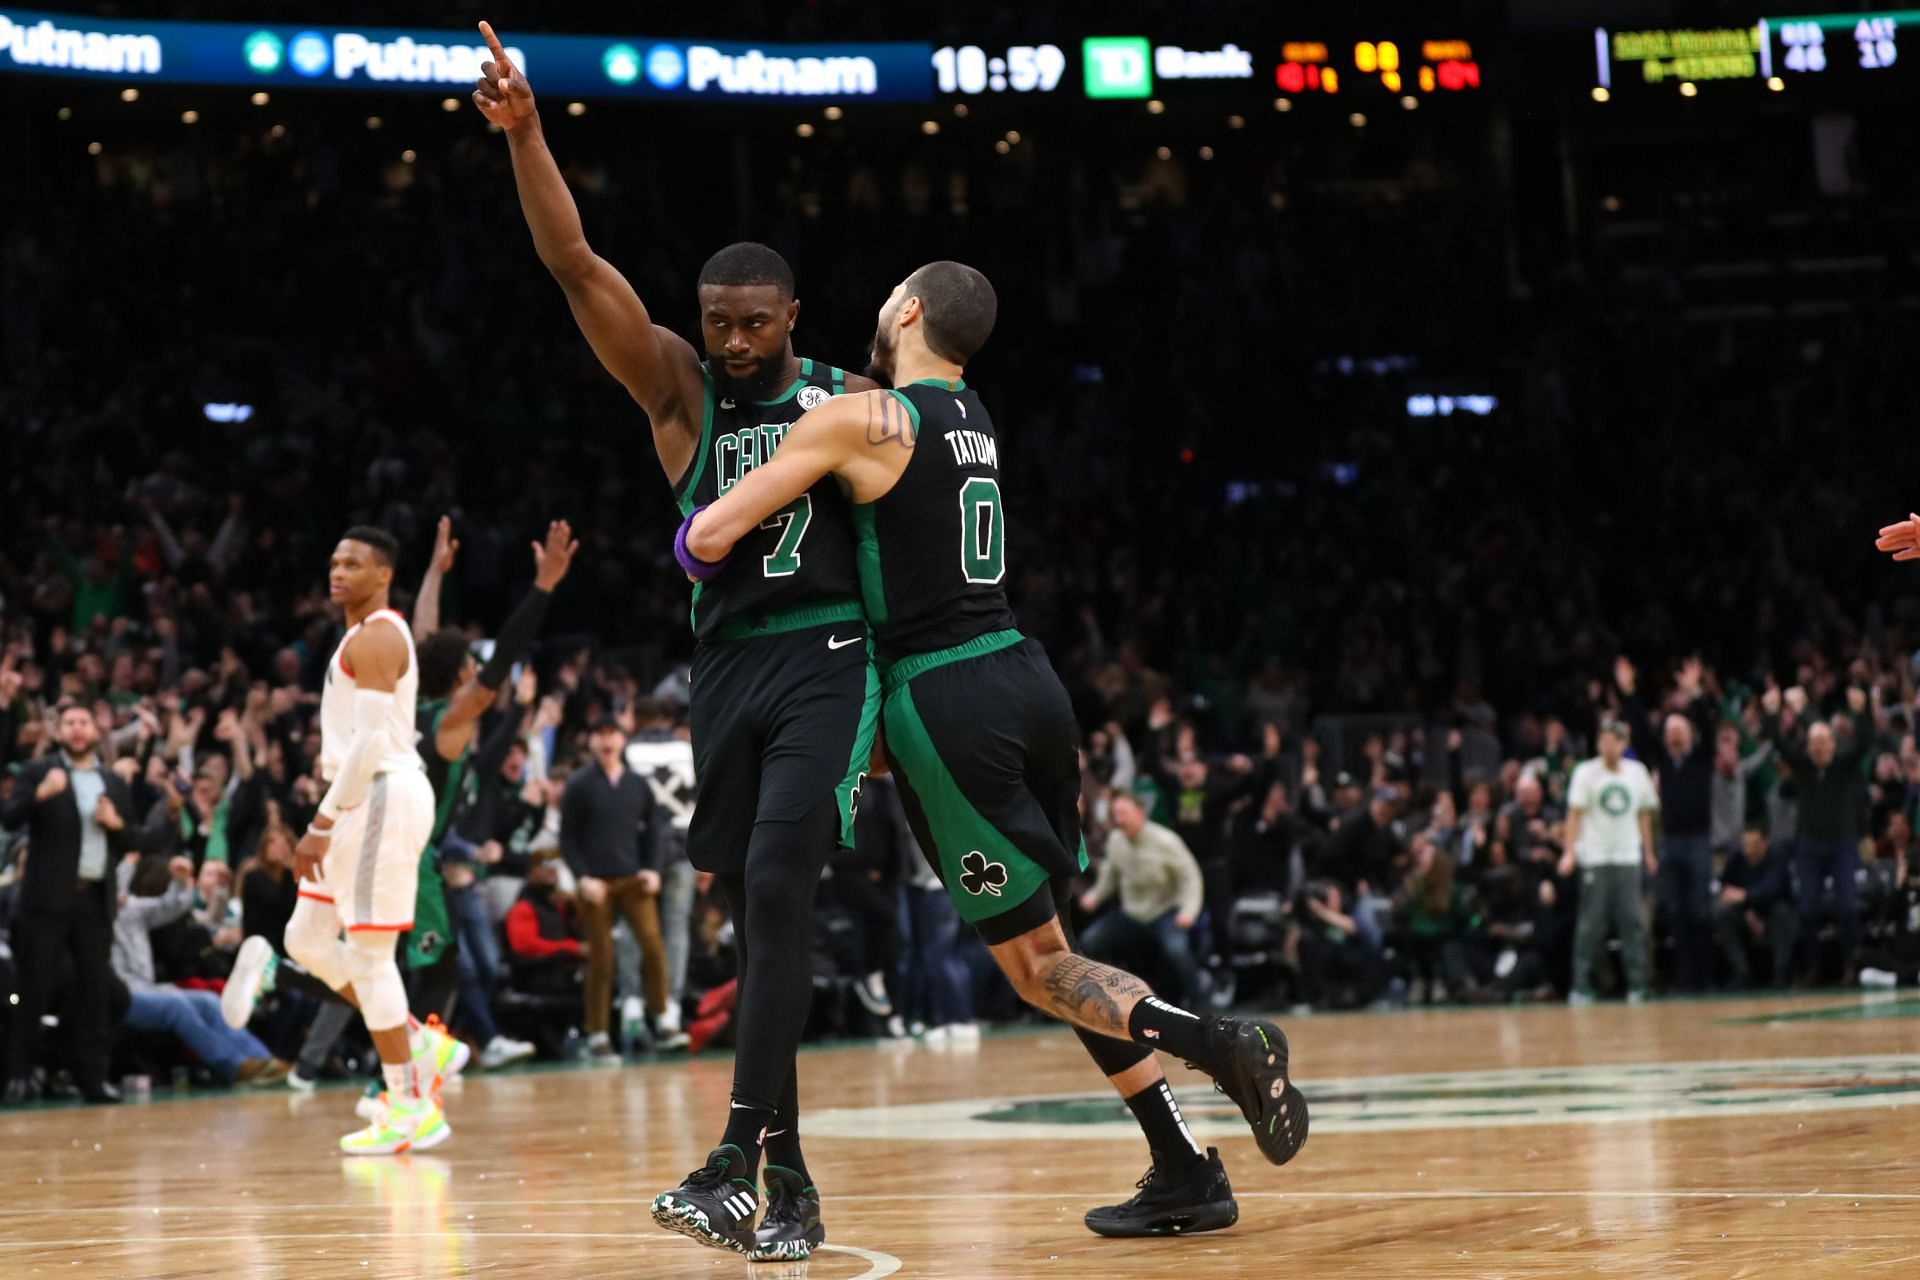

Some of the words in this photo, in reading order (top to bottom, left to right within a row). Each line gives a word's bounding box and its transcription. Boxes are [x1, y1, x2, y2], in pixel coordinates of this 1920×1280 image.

[687, 46, 877, 95] Putnam
[932, 45, 1065, 93] 10:59
[1090, 48, 1143, 85] TD
[1156, 44, 1252, 78] Bank
[715, 422, 797, 499] CELT
[943, 429, 998, 470] TATUM
[760, 492, 813, 578] 7
[959, 477, 1005, 583] 0
